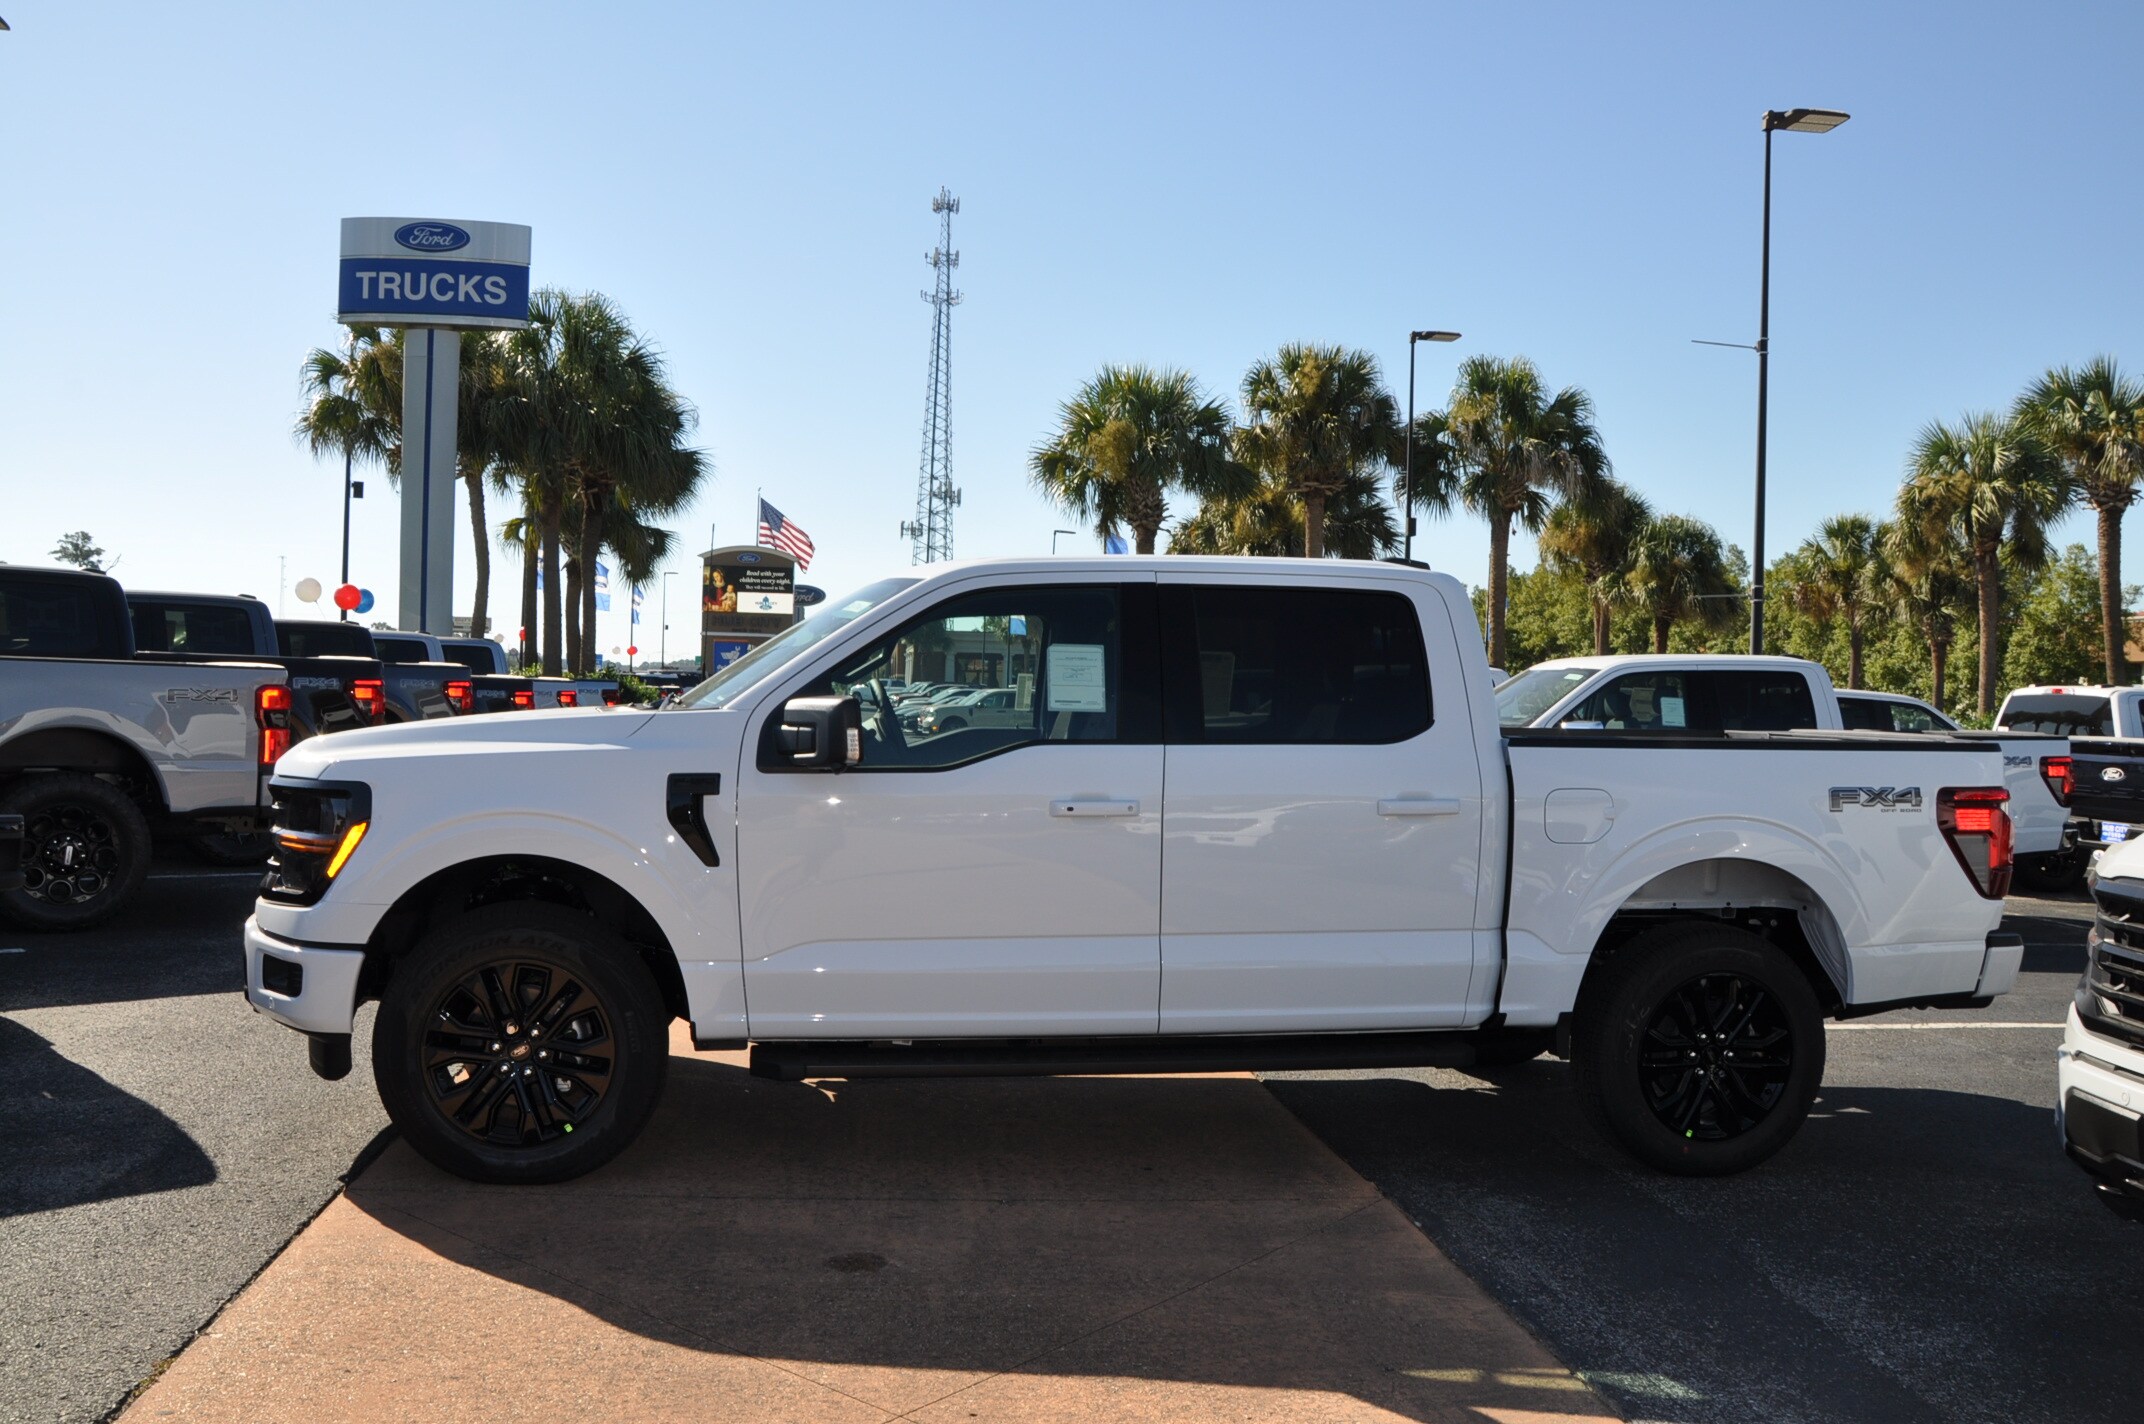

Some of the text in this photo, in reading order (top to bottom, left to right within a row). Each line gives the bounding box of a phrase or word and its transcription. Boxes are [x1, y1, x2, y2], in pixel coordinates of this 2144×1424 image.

[409, 226, 454, 246] Ford
[355, 271, 508, 305] TRUCKS
[293, 677, 340, 690] FX4
[166, 688, 239, 704] FX4
[2004, 756, 2032, 766] X4
[1829, 786, 1923, 812] FX4
